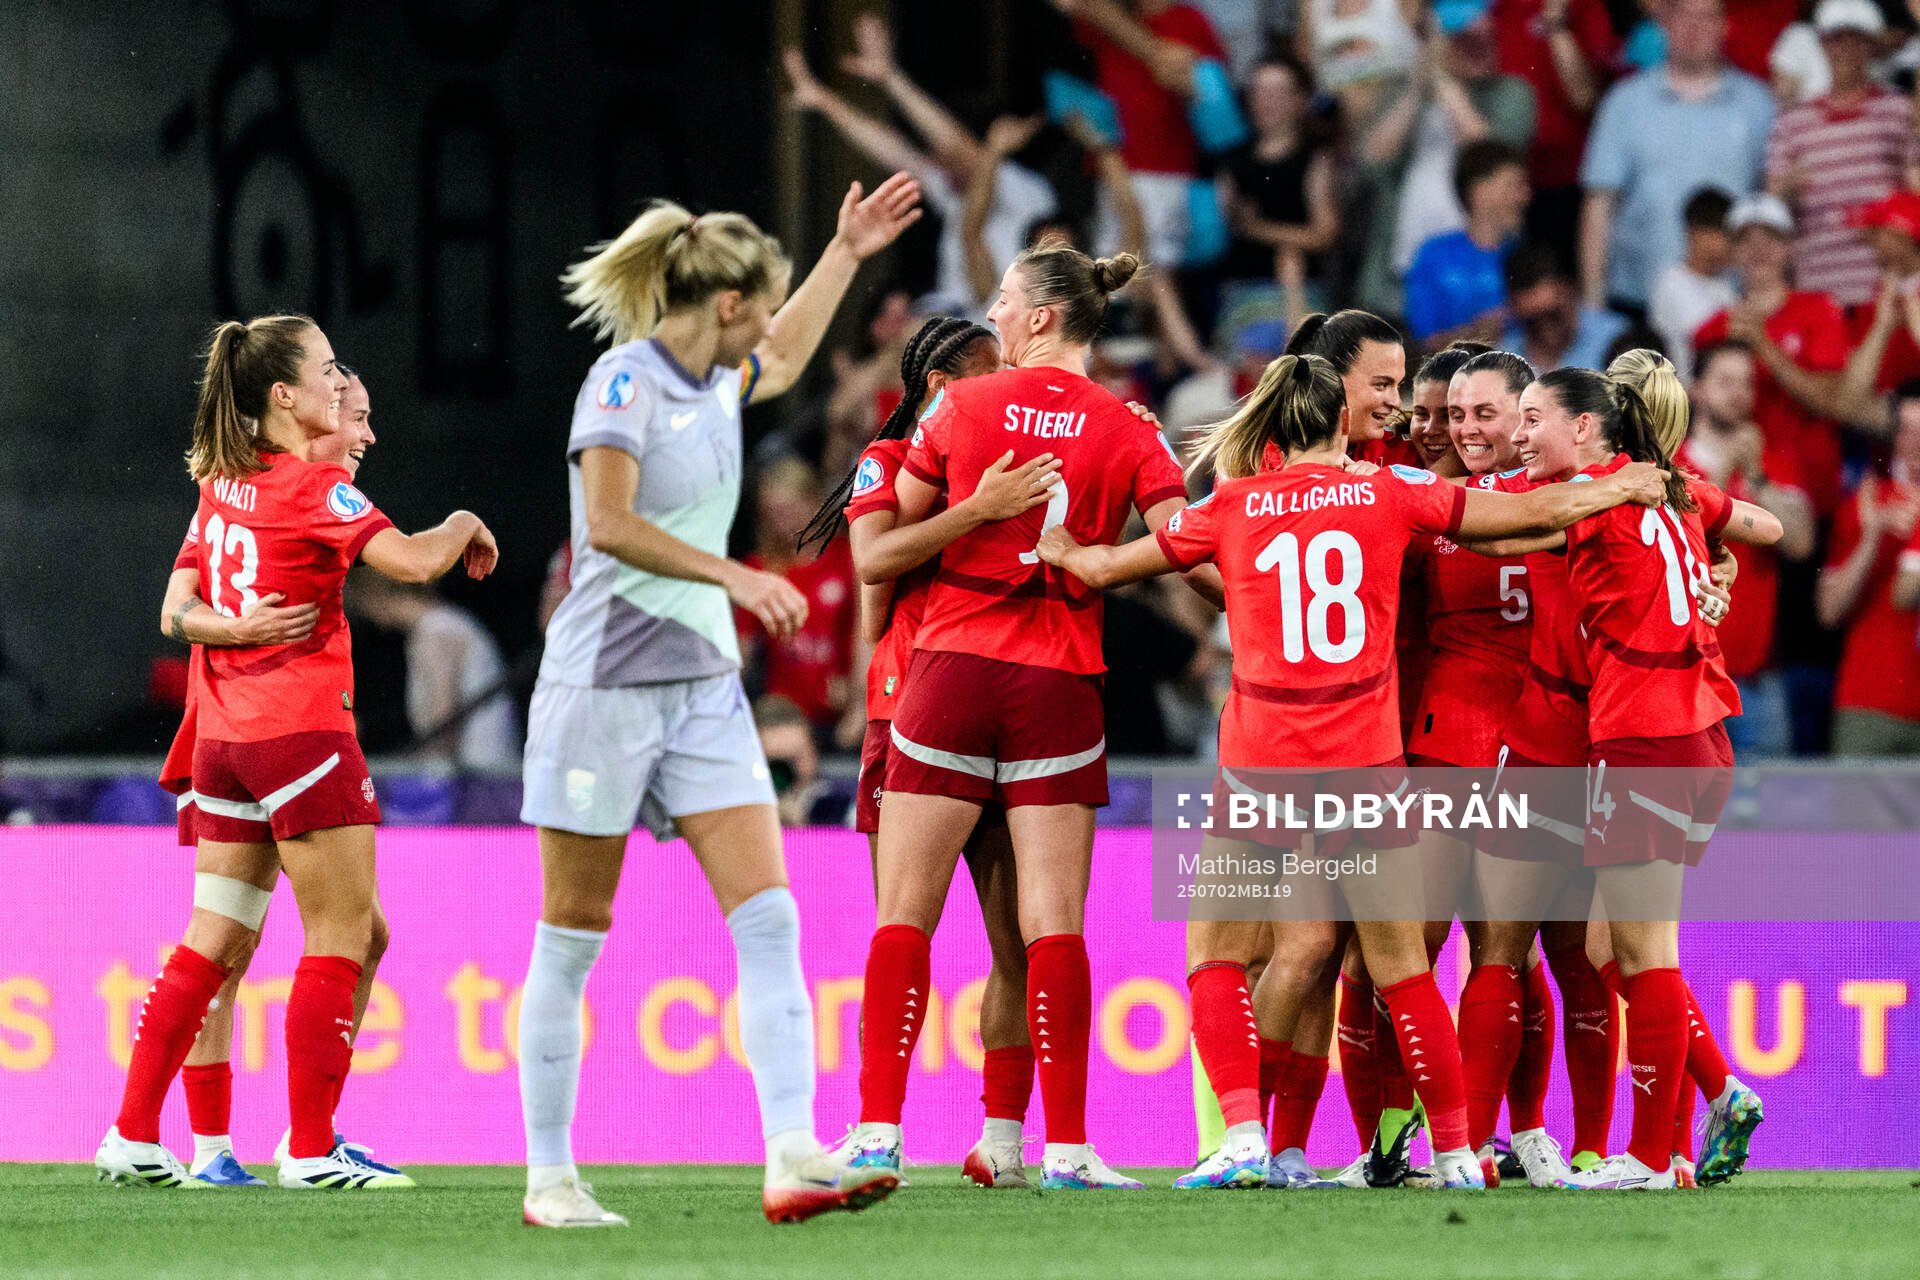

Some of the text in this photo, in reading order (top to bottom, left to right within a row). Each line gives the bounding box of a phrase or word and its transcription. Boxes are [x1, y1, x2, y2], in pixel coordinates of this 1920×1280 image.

[1004, 404, 1086, 438] STIERLI
[1245, 481, 1376, 518] CALLIGARIS
[205, 513, 258, 618] 13
[1254, 530, 1366, 664] 18
[1499, 565, 1528, 622] 5
[97, 944, 404, 1074] te
